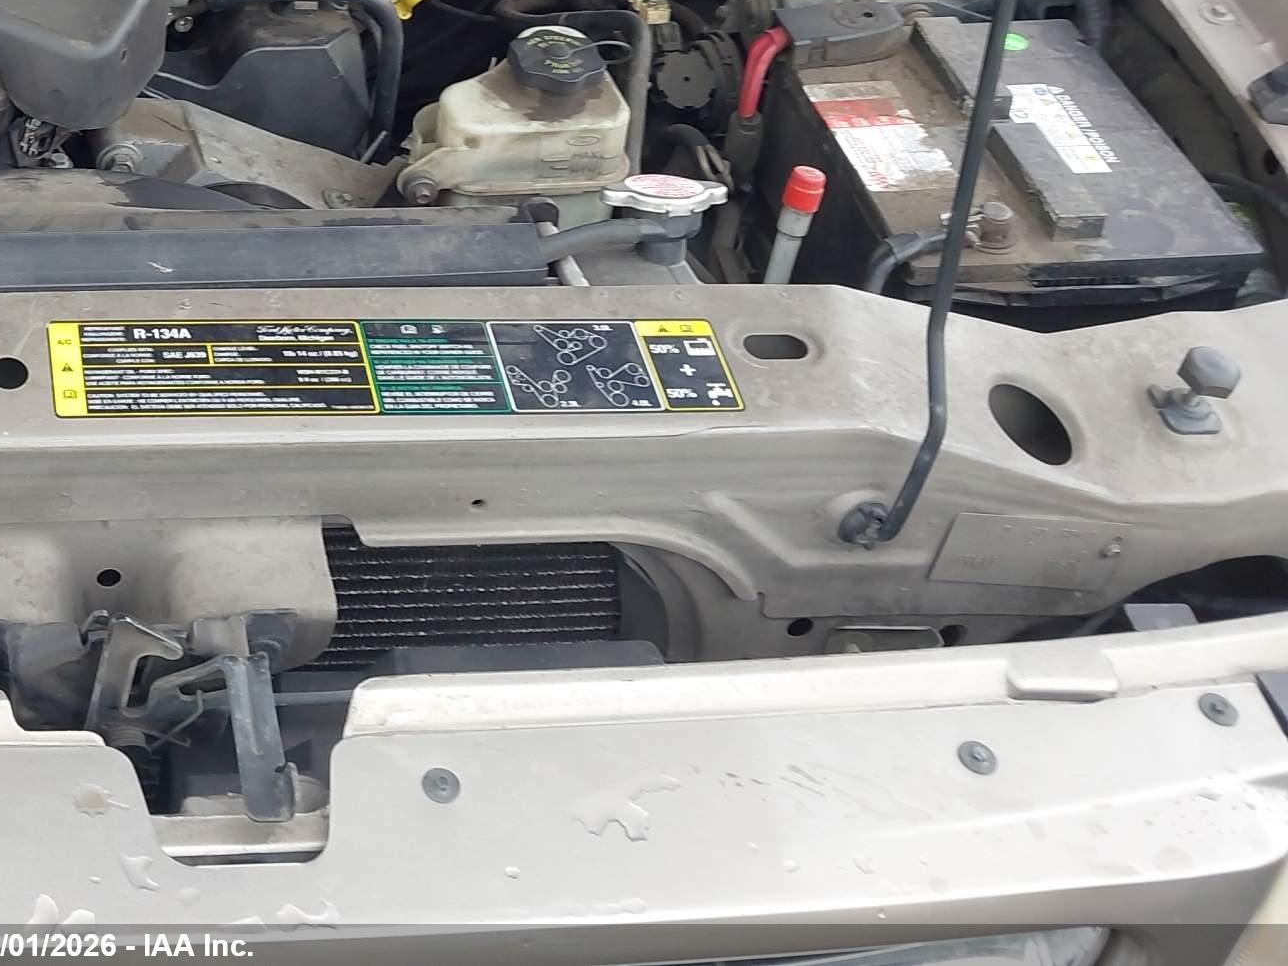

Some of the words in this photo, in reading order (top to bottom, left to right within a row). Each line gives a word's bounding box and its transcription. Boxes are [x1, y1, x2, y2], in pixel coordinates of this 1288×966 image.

[133, 328, 192, 339] R-134A
[648, 344, 681, 354] 50%
[666, 388, 698, 399] 50%
